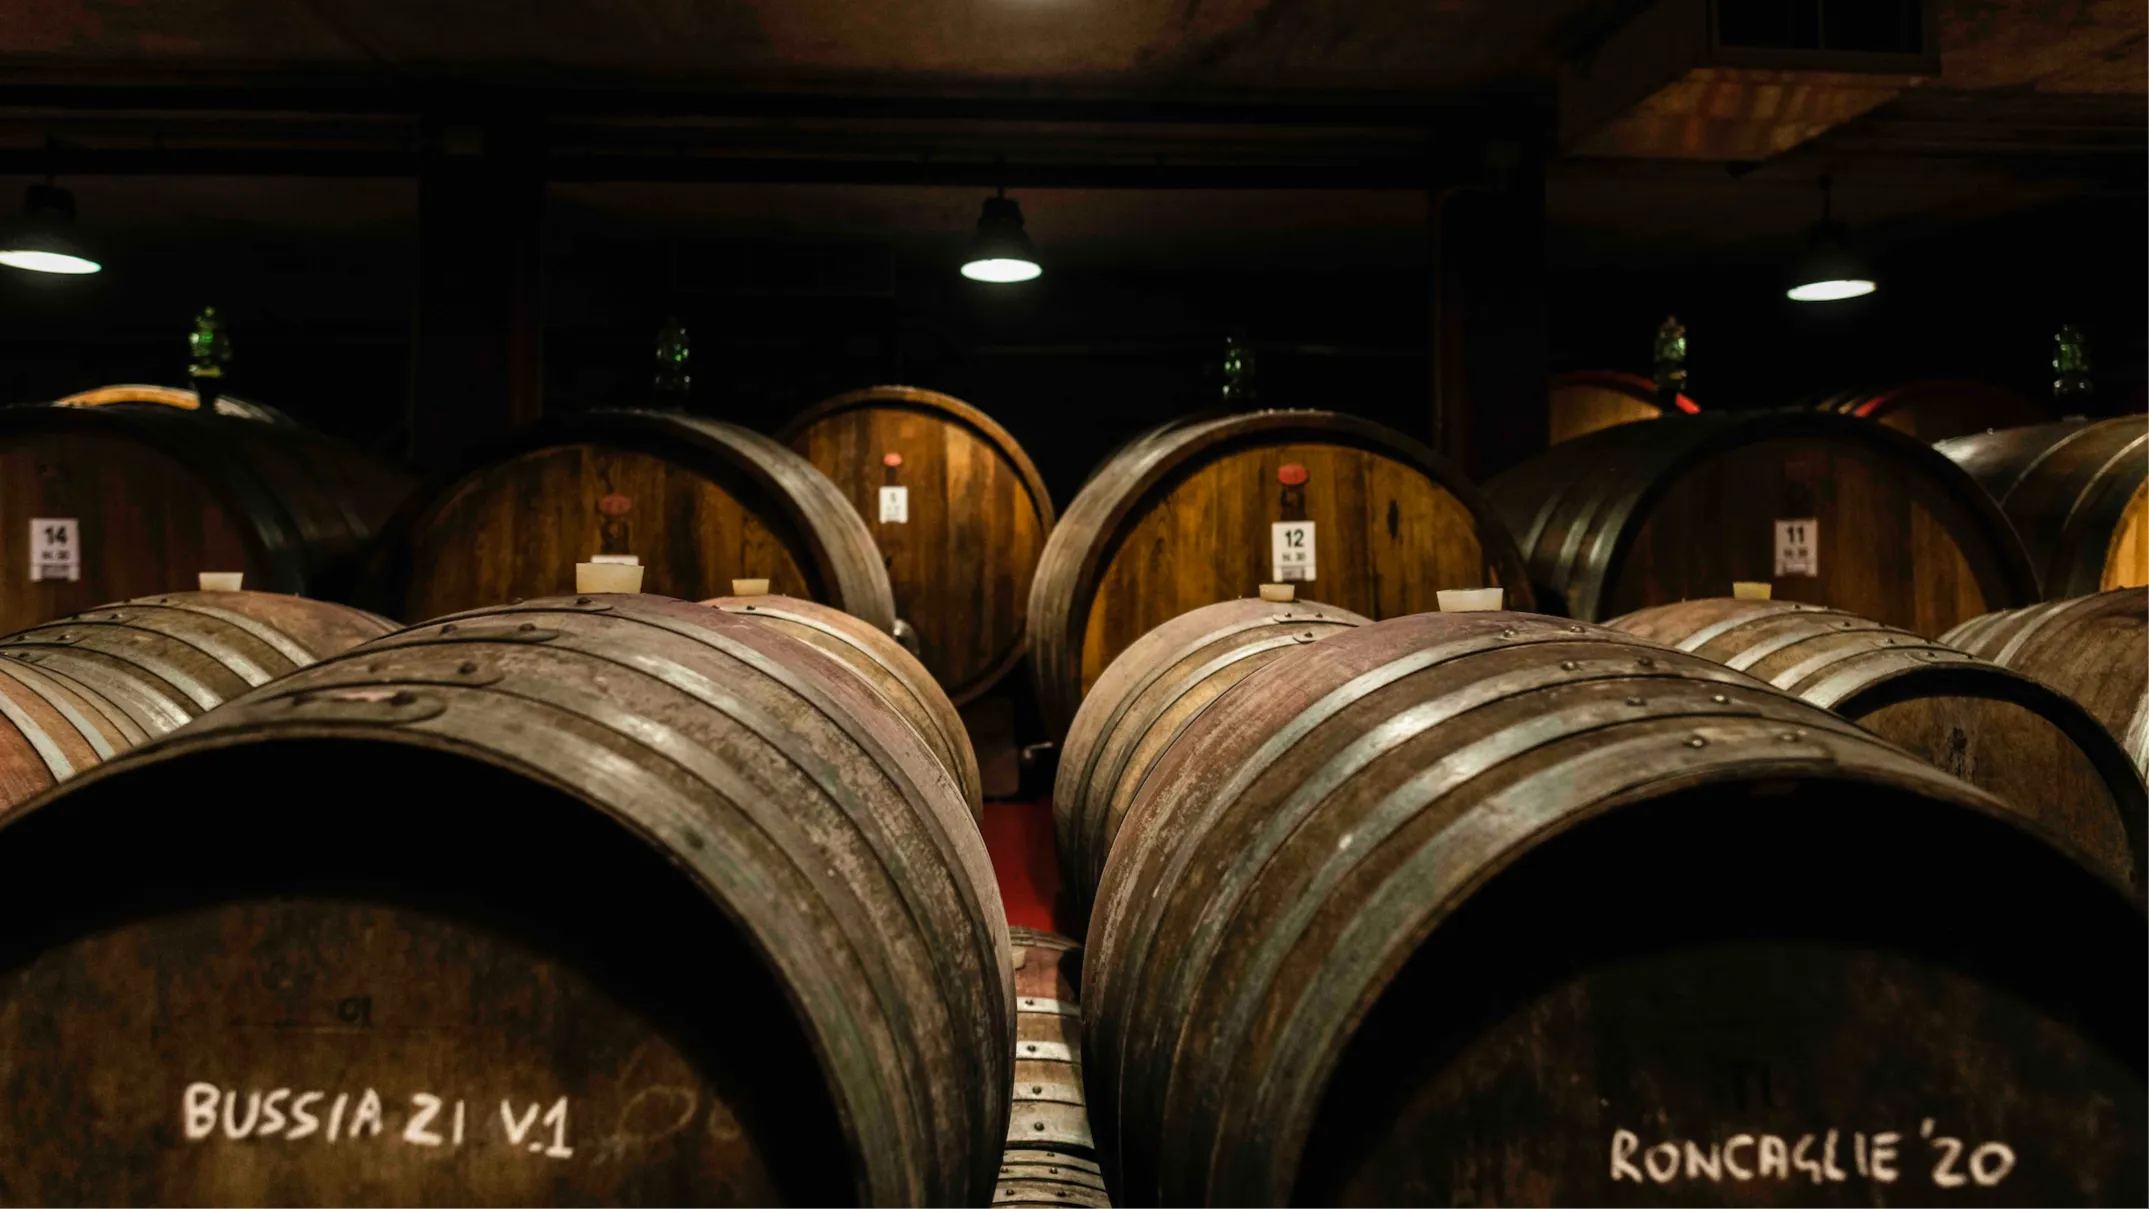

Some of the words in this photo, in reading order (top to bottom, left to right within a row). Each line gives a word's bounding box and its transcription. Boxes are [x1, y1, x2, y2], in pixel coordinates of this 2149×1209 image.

[43, 525, 67, 546] 14
[1284, 528, 1305, 548] 12
[1786, 525, 1805, 545] 11
[182, 1082, 384, 1143] BUSSIA
[500, 1096, 574, 1159] V.1
[1610, 1128, 1900, 1184] RONCAGLIE
